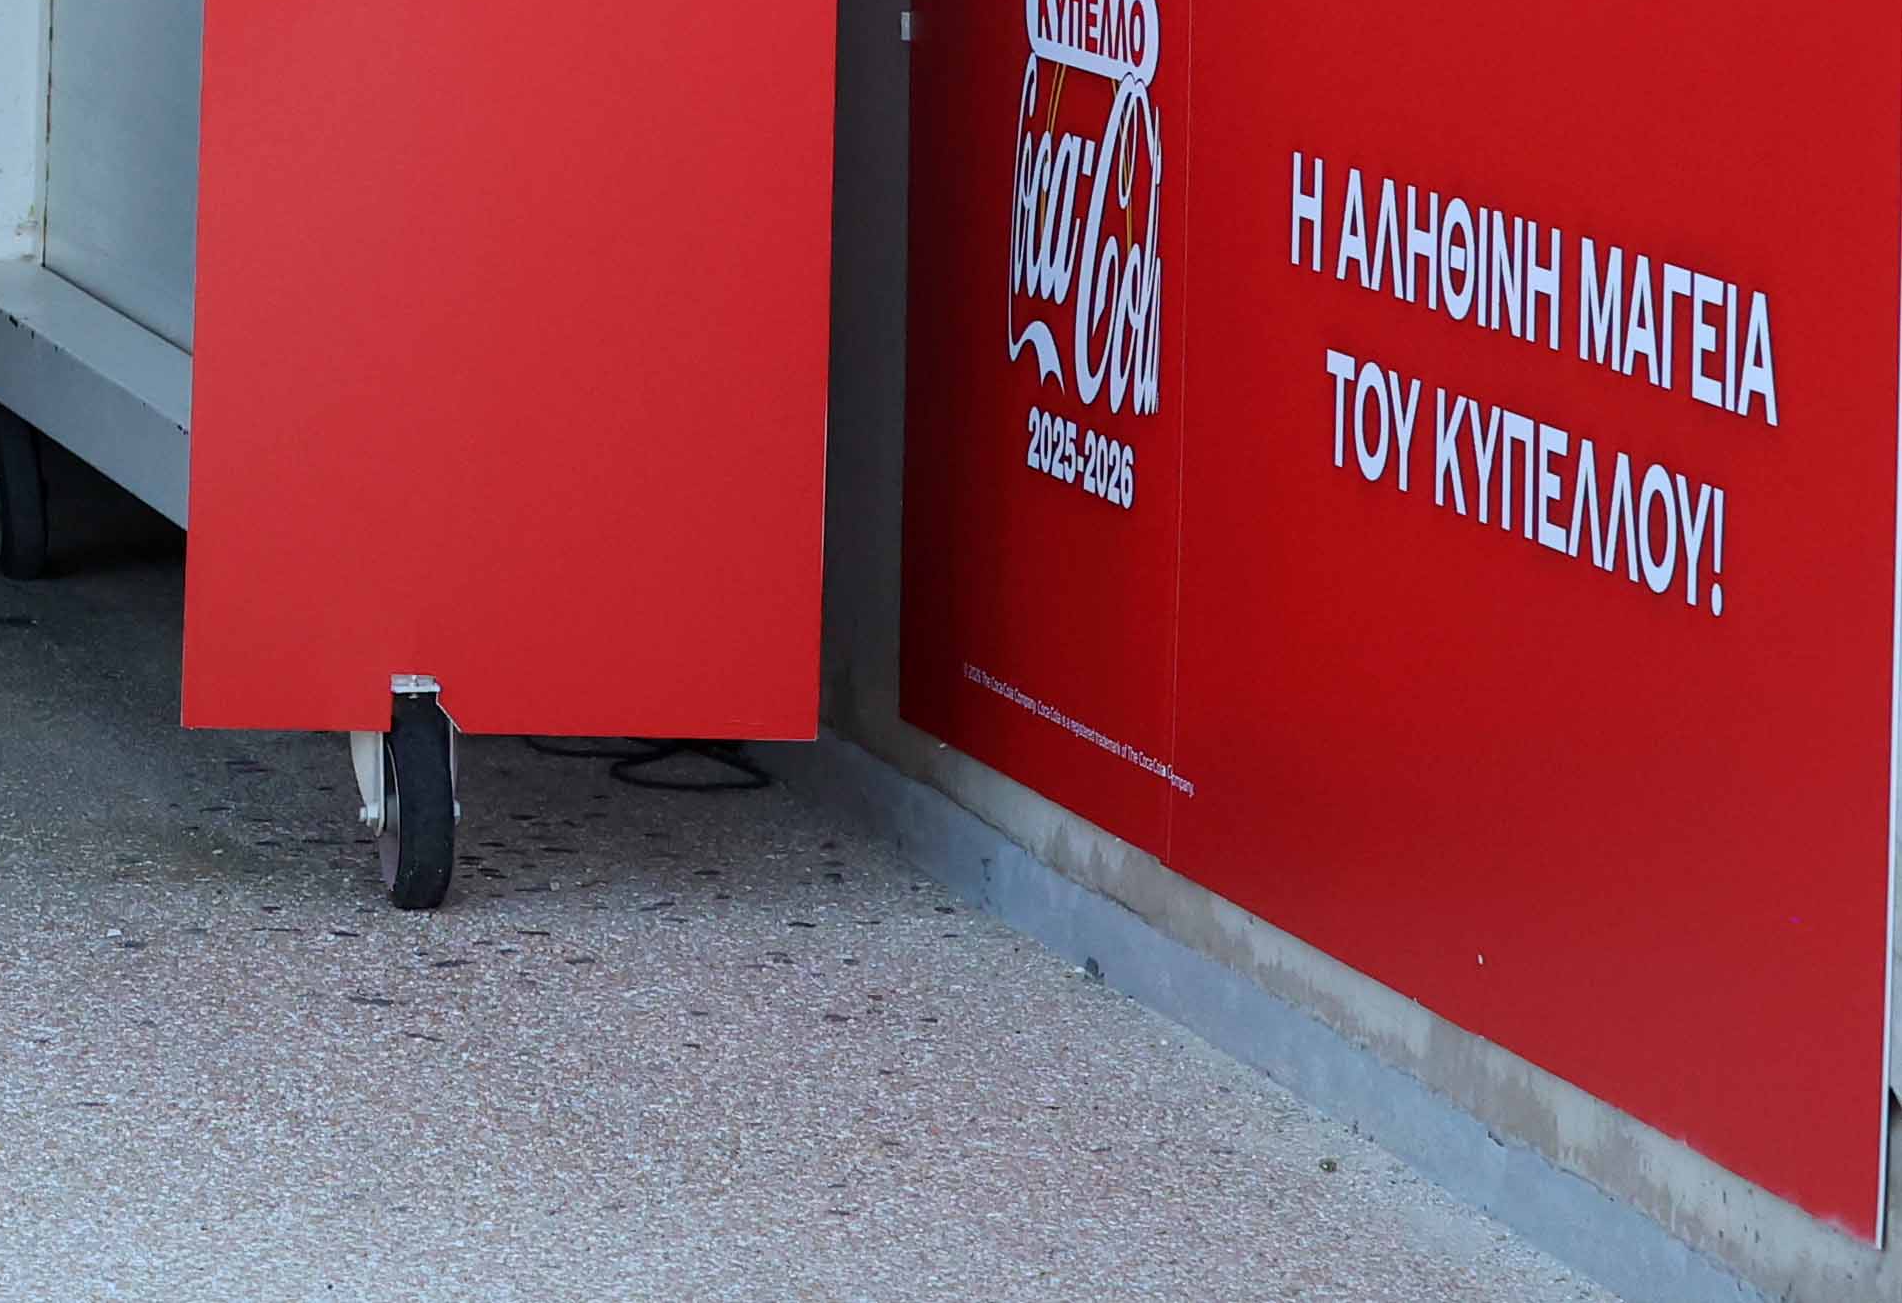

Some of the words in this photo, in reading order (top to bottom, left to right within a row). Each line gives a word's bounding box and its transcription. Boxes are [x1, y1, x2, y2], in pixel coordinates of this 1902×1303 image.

[1291, 151, 1324, 272] Η
[1335, 167, 1562, 353] ΑΛΗΘΙΝΗ
[1579, 236, 1779, 428] ΜΑΓΕΙΑ
[1026, 405, 1134, 510] 2025-2026
[1326, 348, 1422, 494] ΤΟΥ
[1434, 386, 1725, 618] ΚΥΠΕΛΛΟΥ!
